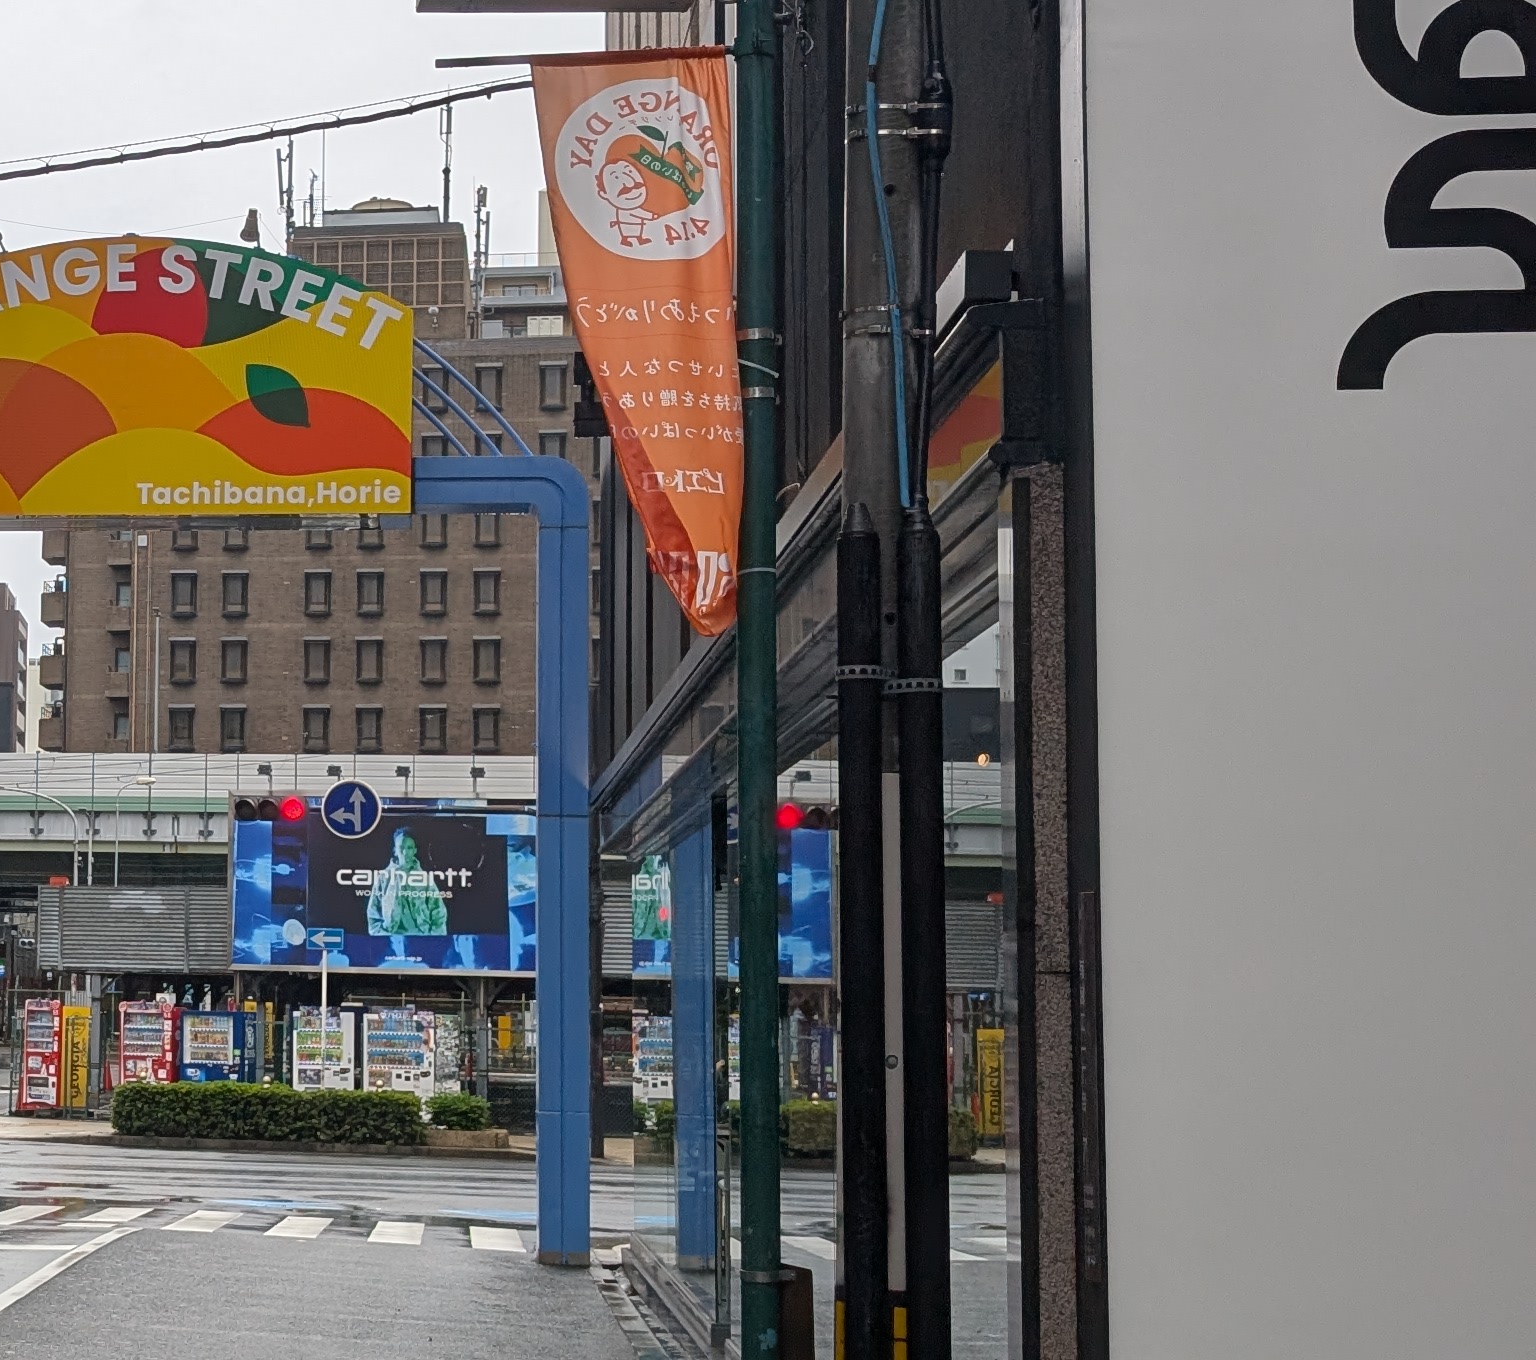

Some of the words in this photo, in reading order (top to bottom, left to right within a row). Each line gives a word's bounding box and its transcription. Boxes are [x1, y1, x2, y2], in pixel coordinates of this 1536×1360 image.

[159, 246, 403, 349] STREET
[336, 868, 472, 888] carhartt
[399, 890, 453, 898] PROGRESS
